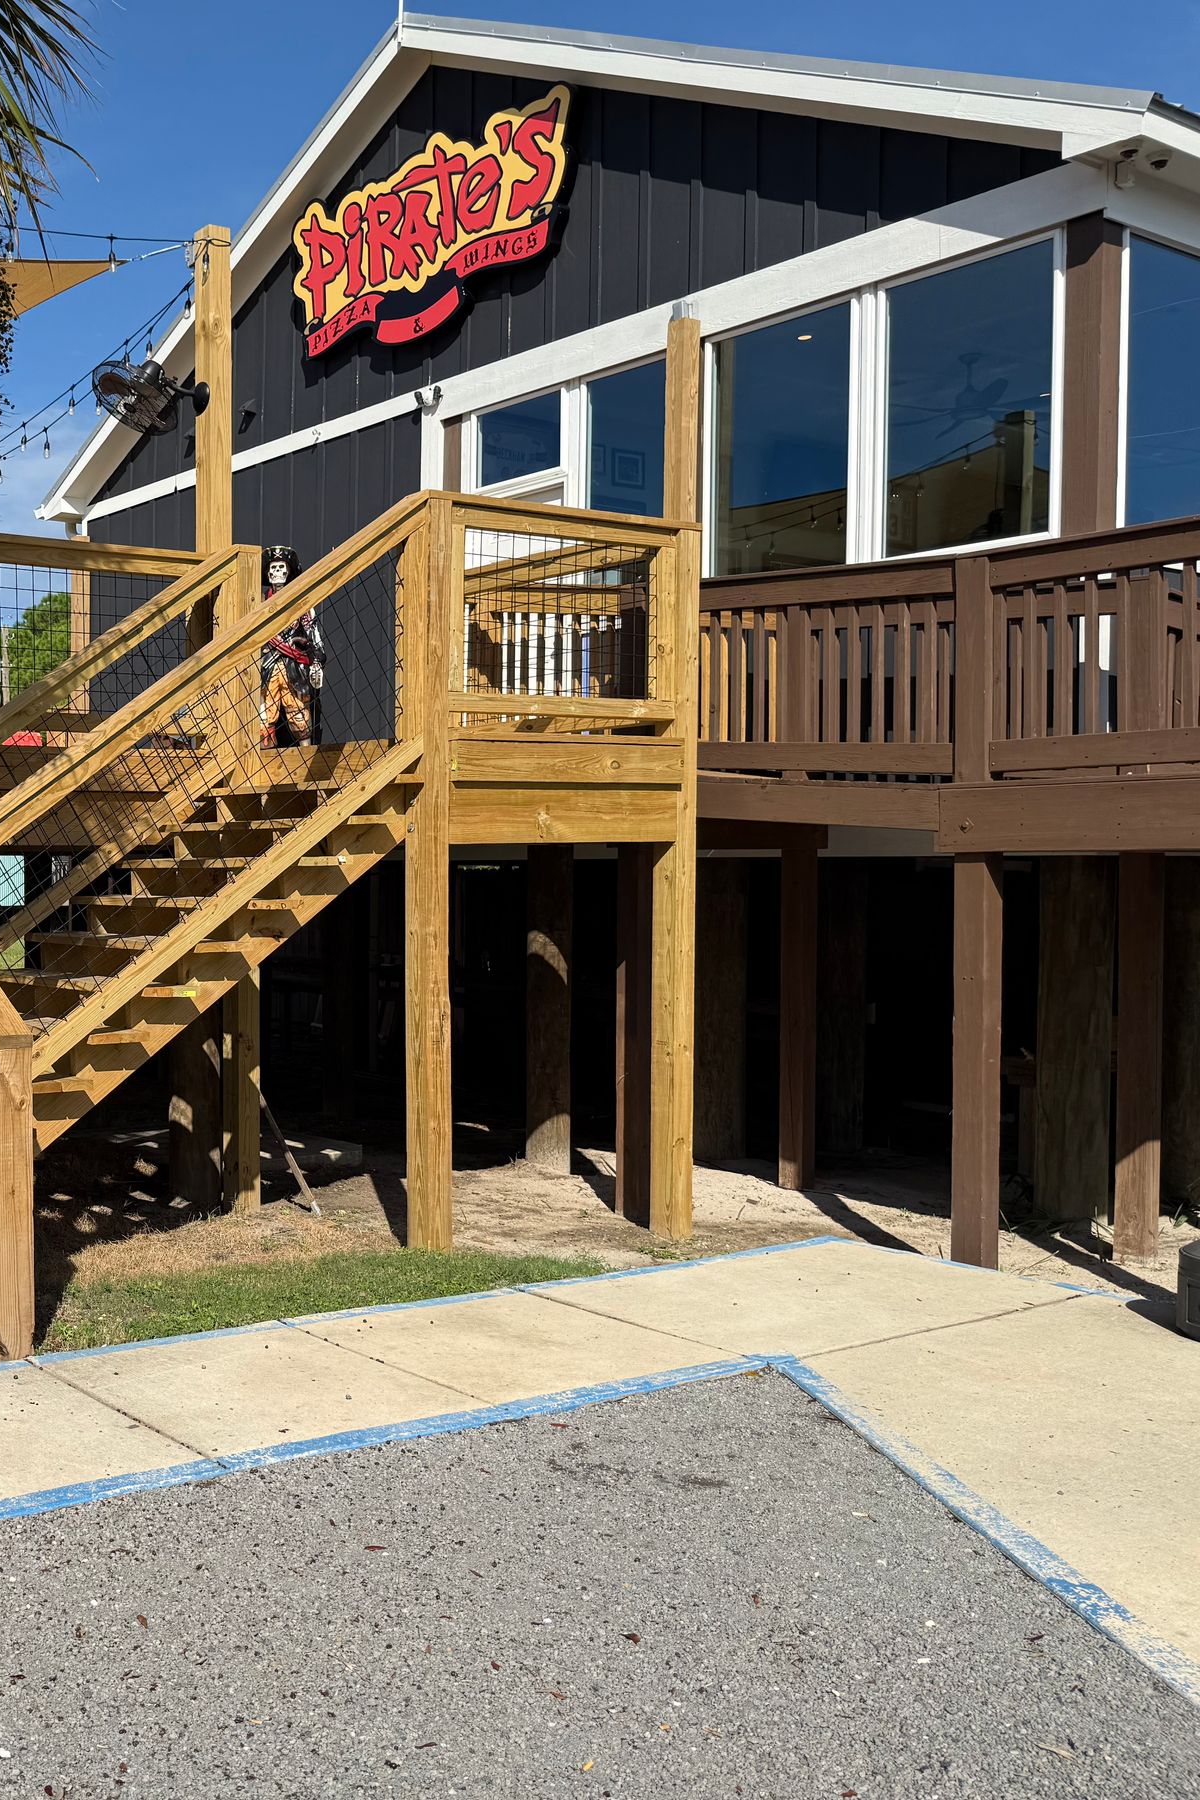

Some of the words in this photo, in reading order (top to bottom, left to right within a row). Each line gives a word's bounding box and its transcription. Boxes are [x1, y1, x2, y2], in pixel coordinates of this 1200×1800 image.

[312, 301, 371, 351] PIZZA
[412, 318, 424, 334] &
[463, 231, 538, 269] WINGS
